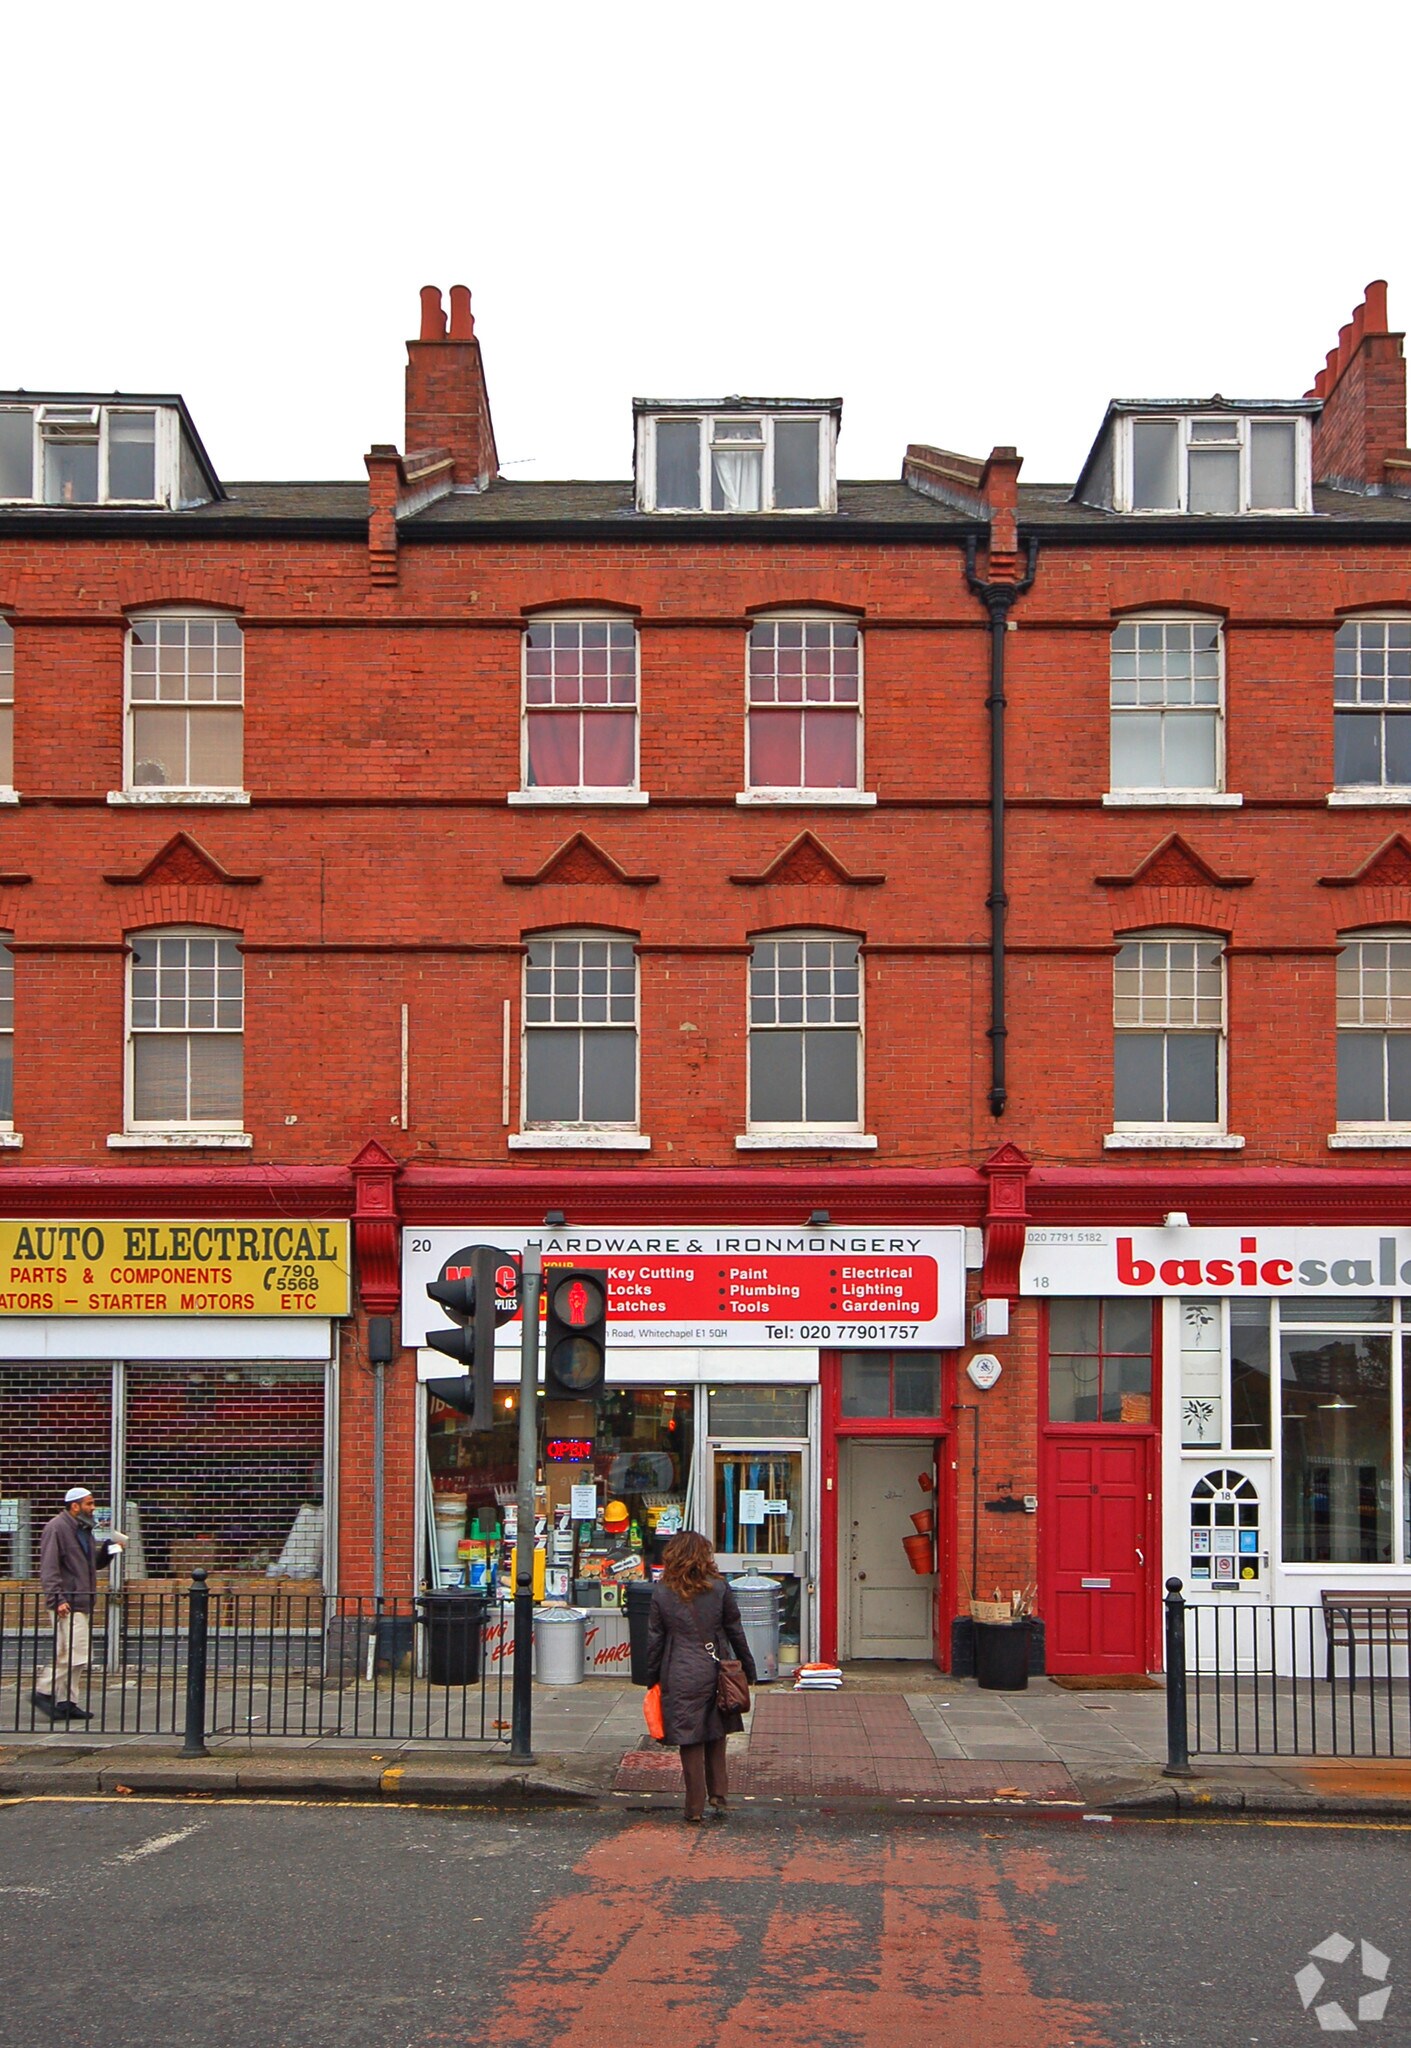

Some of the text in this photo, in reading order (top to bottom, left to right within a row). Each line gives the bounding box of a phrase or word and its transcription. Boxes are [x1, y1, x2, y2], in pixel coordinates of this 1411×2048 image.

[1028, 1233, 1102, 1242] 020 7791 5182
[13, 1227, 338, 1262] AUTO ELECTRICAL
[412, 1239, 432, 1252] 20
[527, 1238, 922, 1252] HARDWARE & IRONMONGERY
[10, 1267, 232, 1284] PARTS & COMPONENTS
[281, 1265, 315, 1278] 790
[608, 1267, 695, 1282] Key Cutting
[730, 1267, 768, 1280] Paint
[842, 1266, 913, 1279] Electrical
[276, 1278, 319, 1291] 5568
[1033, 1276, 1050, 1288] 18
[608, 1283, 653, 1296] Locks
[730, 1284, 800, 1298] Plumbing
[842, 1283, 903, 1297] Lighting
[88, 1293, 167, 1310] STARTER
[181, 1293, 255, 1310] MOTORS
[281, 1293, 317, 1310] ETC
[608, 1299, 667, 1313] Latches
[730, 1300, 770, 1313] Tools
[842, 1299, 920, 1314] Gardening
[611, 1328, 636, 1339] Road,
[639, 1328, 693, 1339] Whitechapel
[765, 1325, 919, 1339] Tel: 020 77901757
[547, 1442, 591, 1457] OPEN
[1221, 1492, 1231, 1500] 18
